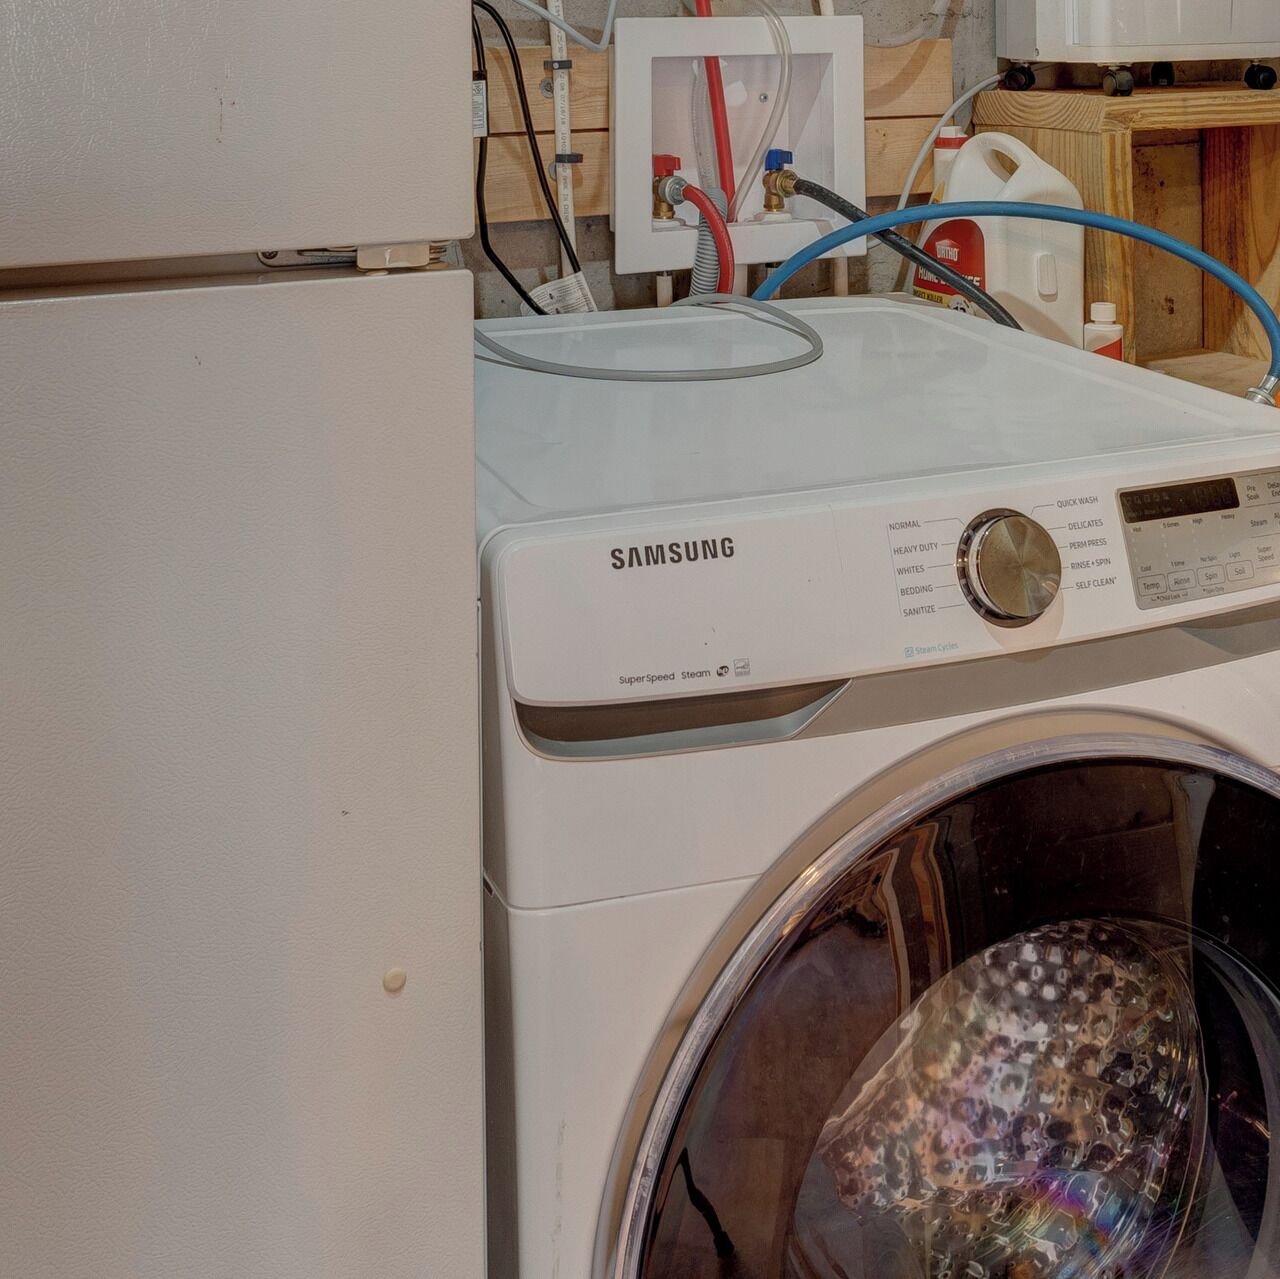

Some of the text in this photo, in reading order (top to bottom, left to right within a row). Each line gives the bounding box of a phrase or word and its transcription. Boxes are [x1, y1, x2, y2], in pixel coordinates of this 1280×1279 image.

[937, 246, 958, 261] ORTHO
[1056, 496, 1098, 508] QUICK WASH
[889, 520, 922, 531] NORMAL
[1068, 519, 1103, 530] DELICATES
[893, 542, 939, 555] HEAVY DUTY
[1069, 538, 1107, 551] PERM PRESS
[610, 537, 734, 569] SAMSUNG
[896, 565, 925, 575] WHITES
[1204, 572, 1218, 581] Spin
[900, 584, 934, 596] BEDDING
[1075, 580, 1092, 590] SELF
[903, 605, 936, 617] SANITIZE
[915, 642, 959, 655] Steam Cycles
[620, 674, 645, 686] Super
[646, 673, 675, 684] Speed
[681, 669, 711, 680] Steam
